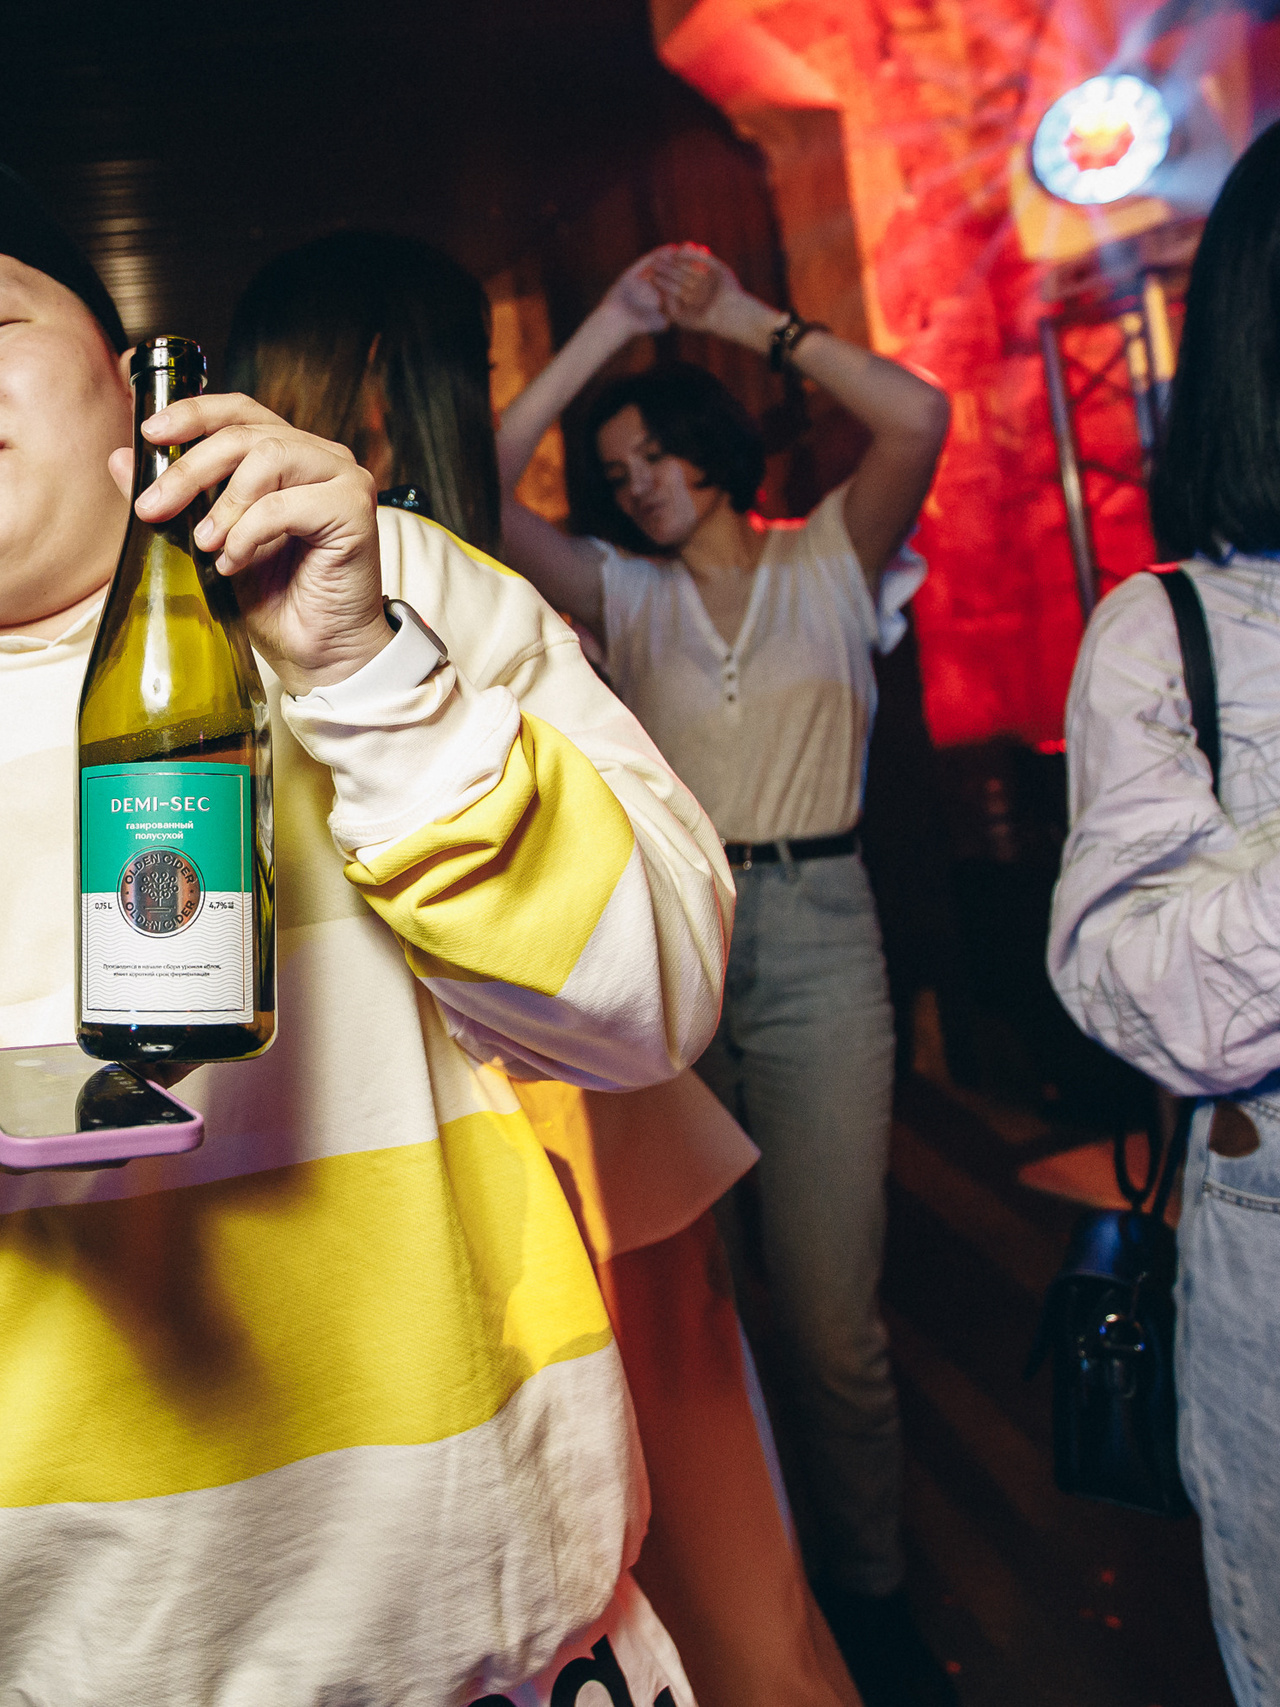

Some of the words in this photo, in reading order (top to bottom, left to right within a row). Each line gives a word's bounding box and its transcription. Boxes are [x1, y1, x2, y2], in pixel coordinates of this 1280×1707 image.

[111, 796, 210, 813] DEMI-SEC
[126, 821, 194, 831] газированный
[135, 831, 184, 841] полусухой
[125, 853, 160, 884] OLDEN
[163, 854, 196, 884] CIDER
[125, 901, 160, 931] OLDEN
[163, 900, 195, 931] CIDER
